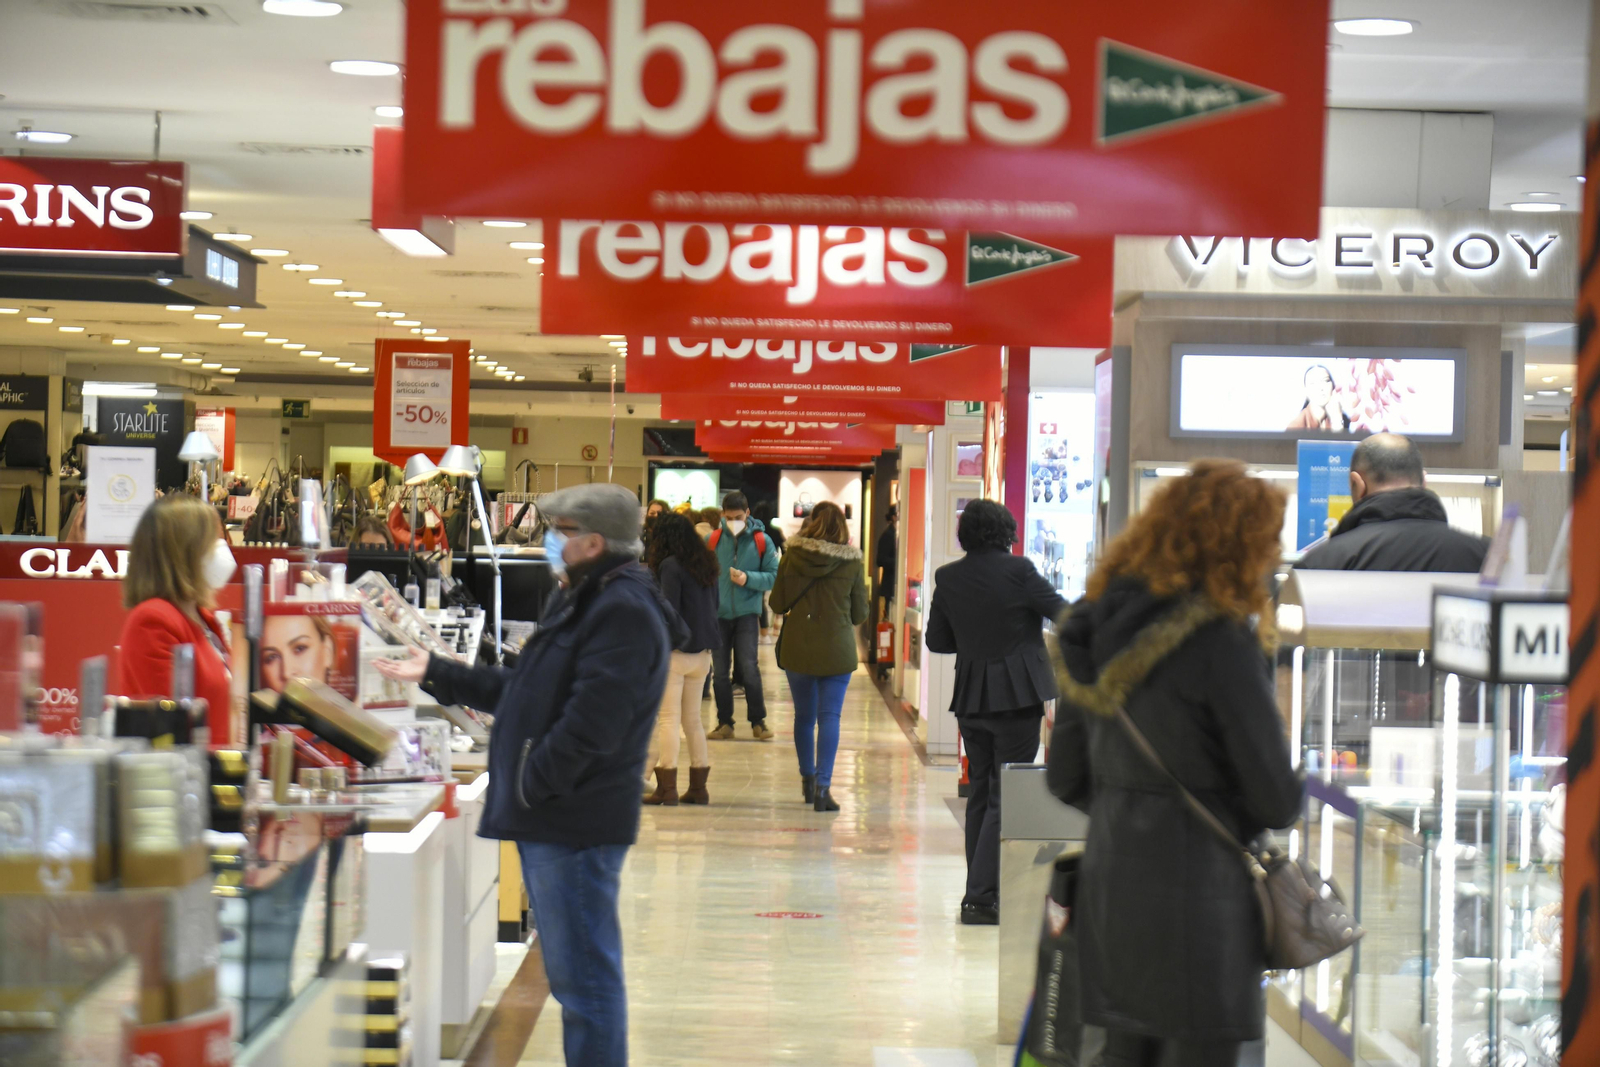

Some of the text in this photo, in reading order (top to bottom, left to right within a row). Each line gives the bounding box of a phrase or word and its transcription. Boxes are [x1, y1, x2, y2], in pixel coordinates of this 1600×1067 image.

[440, 0, 1070, 174] rebajas
[1180, 232, 1559, 271] VICEROY
[558, 222, 948, 305] rebajas
[704, 316, 719, 327] NO
[0, 392, 24, 403] PHIC
[113, 412, 169, 433] STARLITE
[396, 404, 448, 424] -50%
[305, 603, 360, 614] CLARINS
